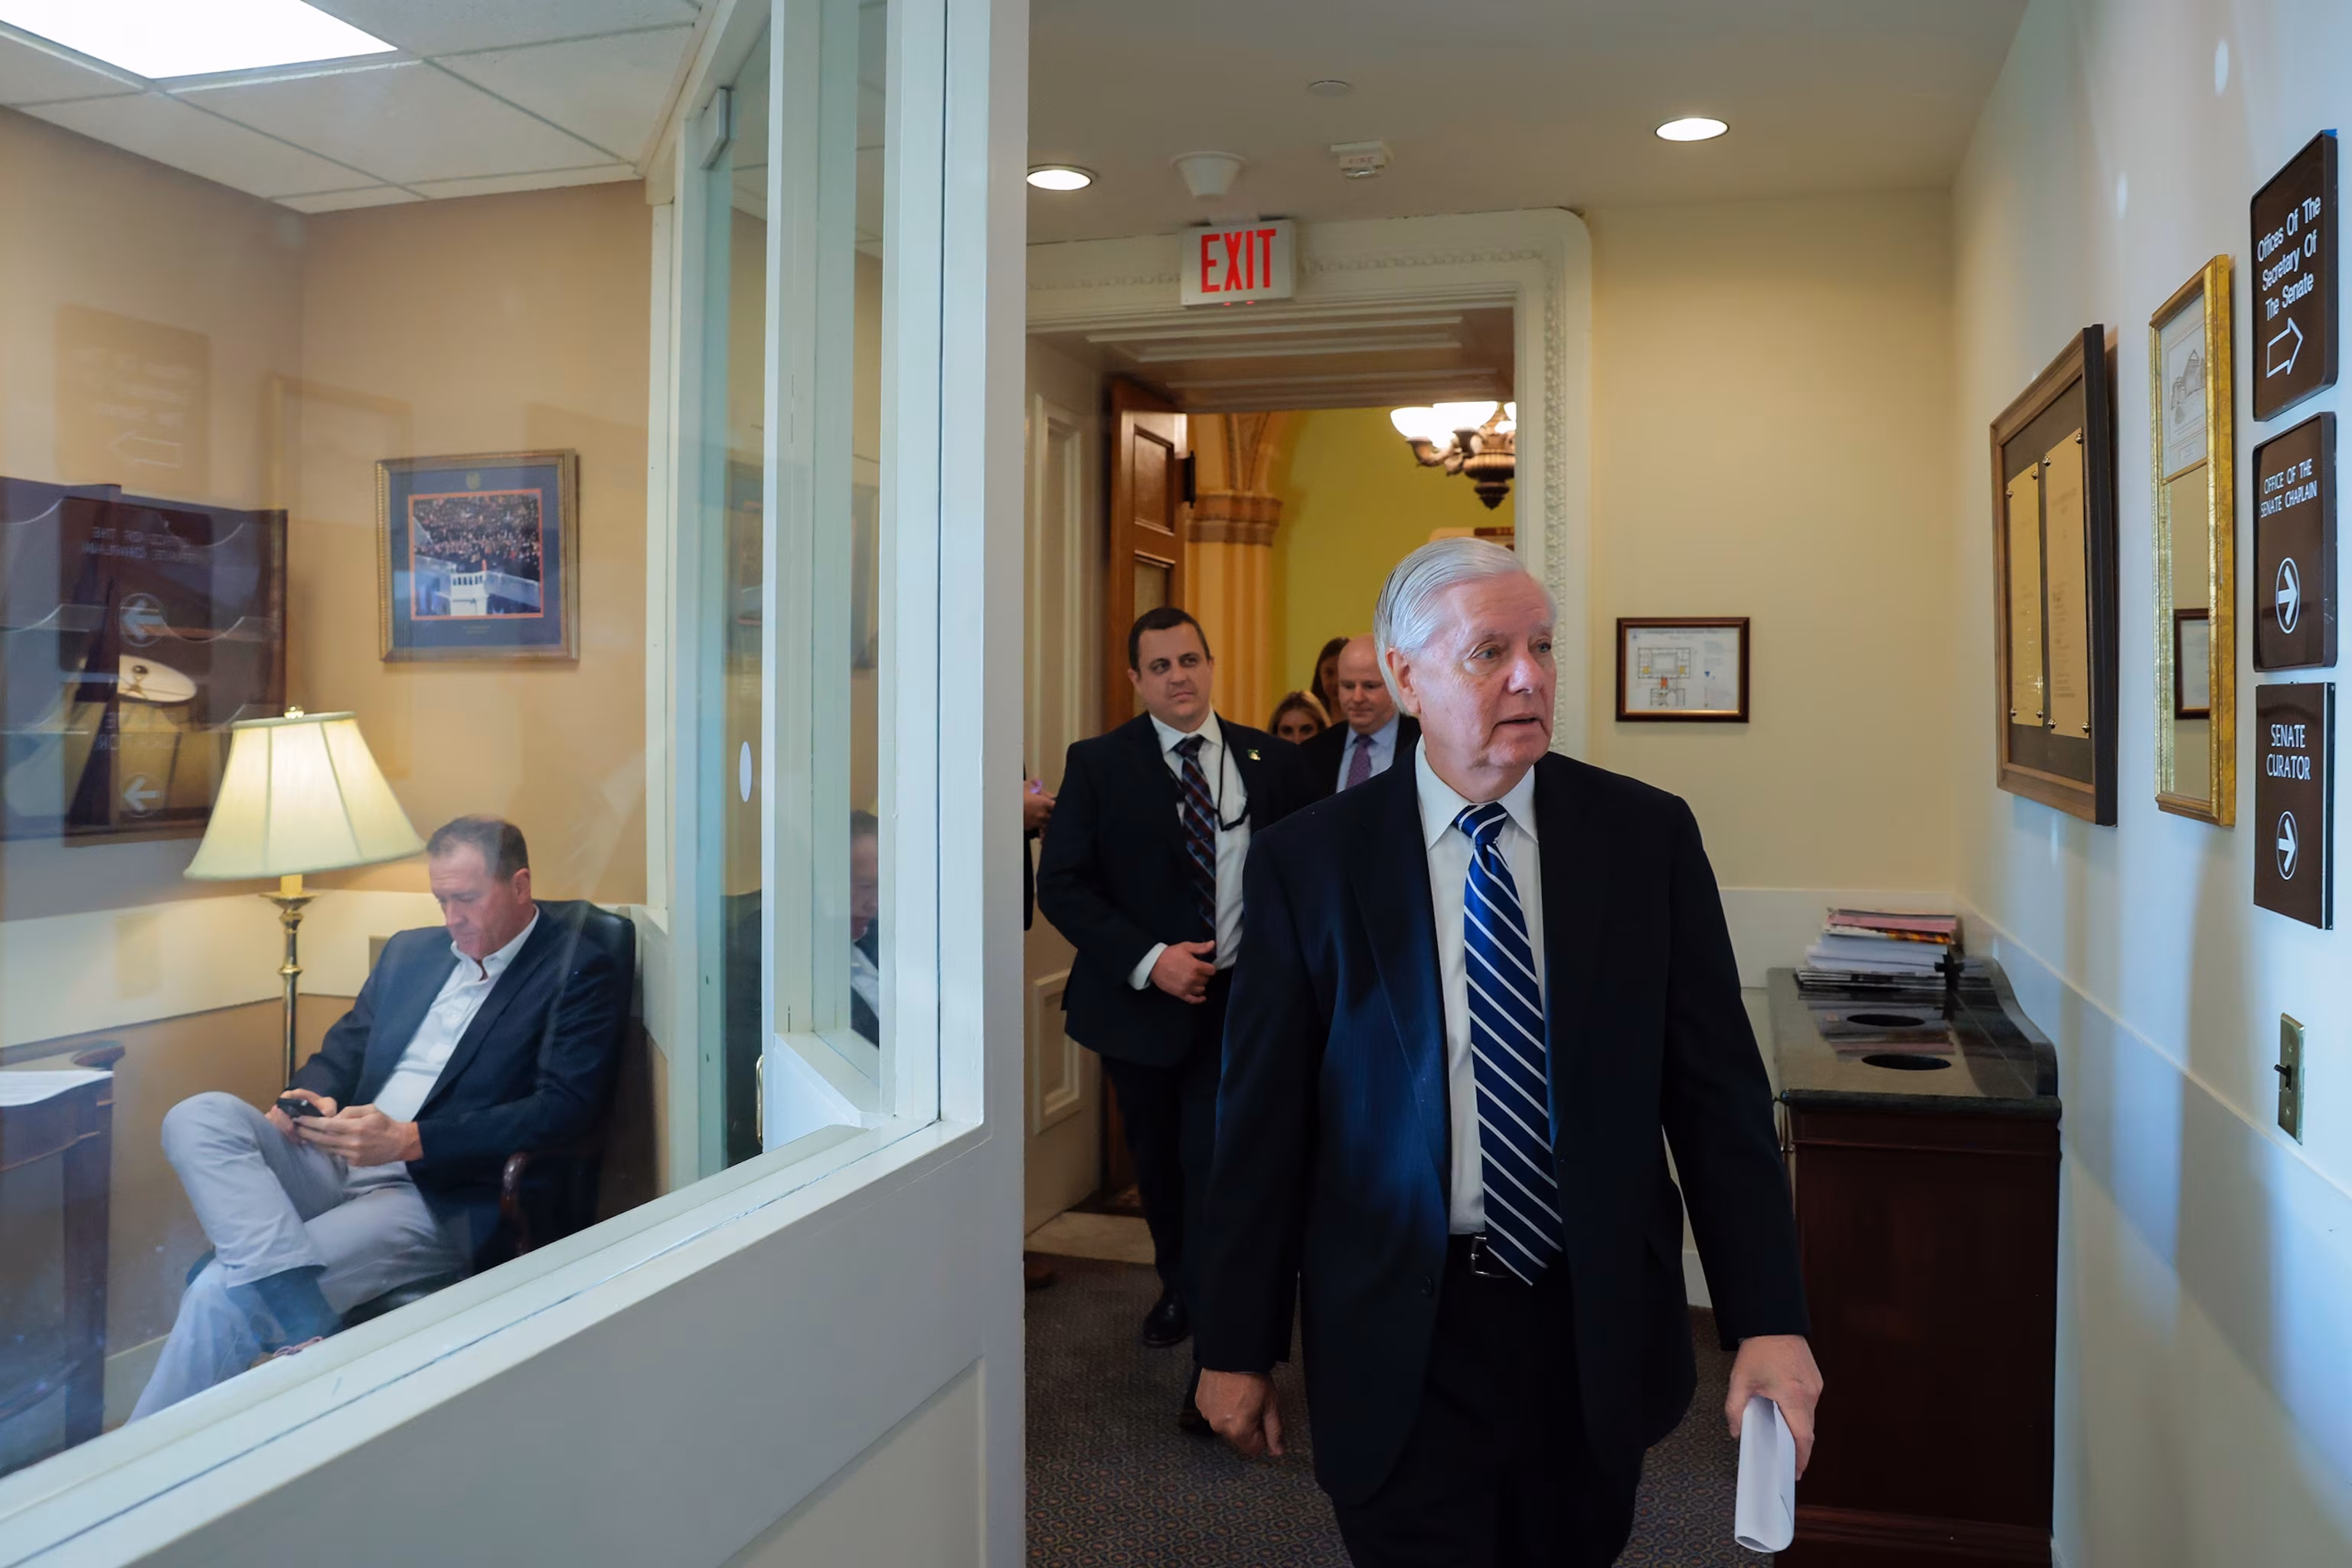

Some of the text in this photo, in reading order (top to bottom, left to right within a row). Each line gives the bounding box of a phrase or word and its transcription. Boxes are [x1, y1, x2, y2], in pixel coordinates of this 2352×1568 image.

[2257, 196, 2321, 262] Offices Of The
[1201, 228, 1276, 293] EXIT
[2262, 228, 2317, 291] Secretary Of
[2265, 272, 2314, 321] The Senate
[2263, 458, 2313, 495] OFFICE OF THE
[2260, 480, 2318, 518] SENATE CHAPLAIN
[2270, 723, 2306, 749] SENATE
[2265, 753, 2311, 780] CURATOR
